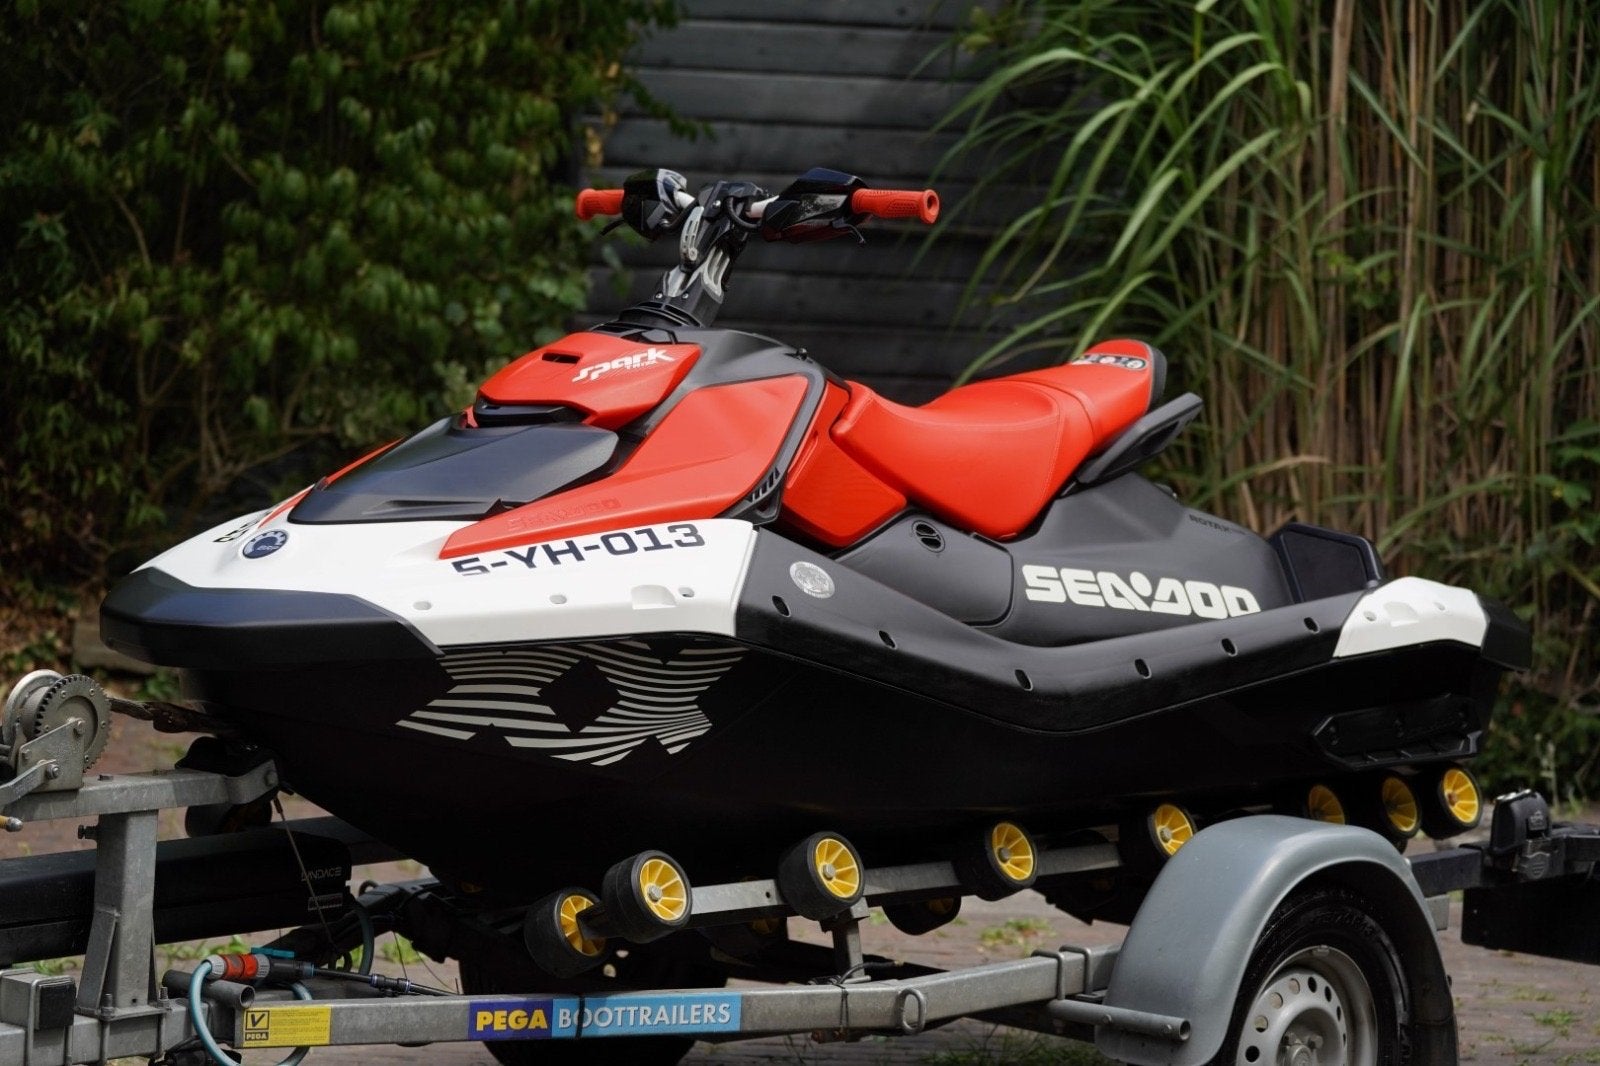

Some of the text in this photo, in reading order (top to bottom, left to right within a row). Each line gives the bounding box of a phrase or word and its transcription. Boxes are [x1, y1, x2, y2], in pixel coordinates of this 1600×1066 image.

[451, 523, 705, 577] 5-YH-013
[476, 1004, 730, 1031] PEGA BOOTTRAILERS
